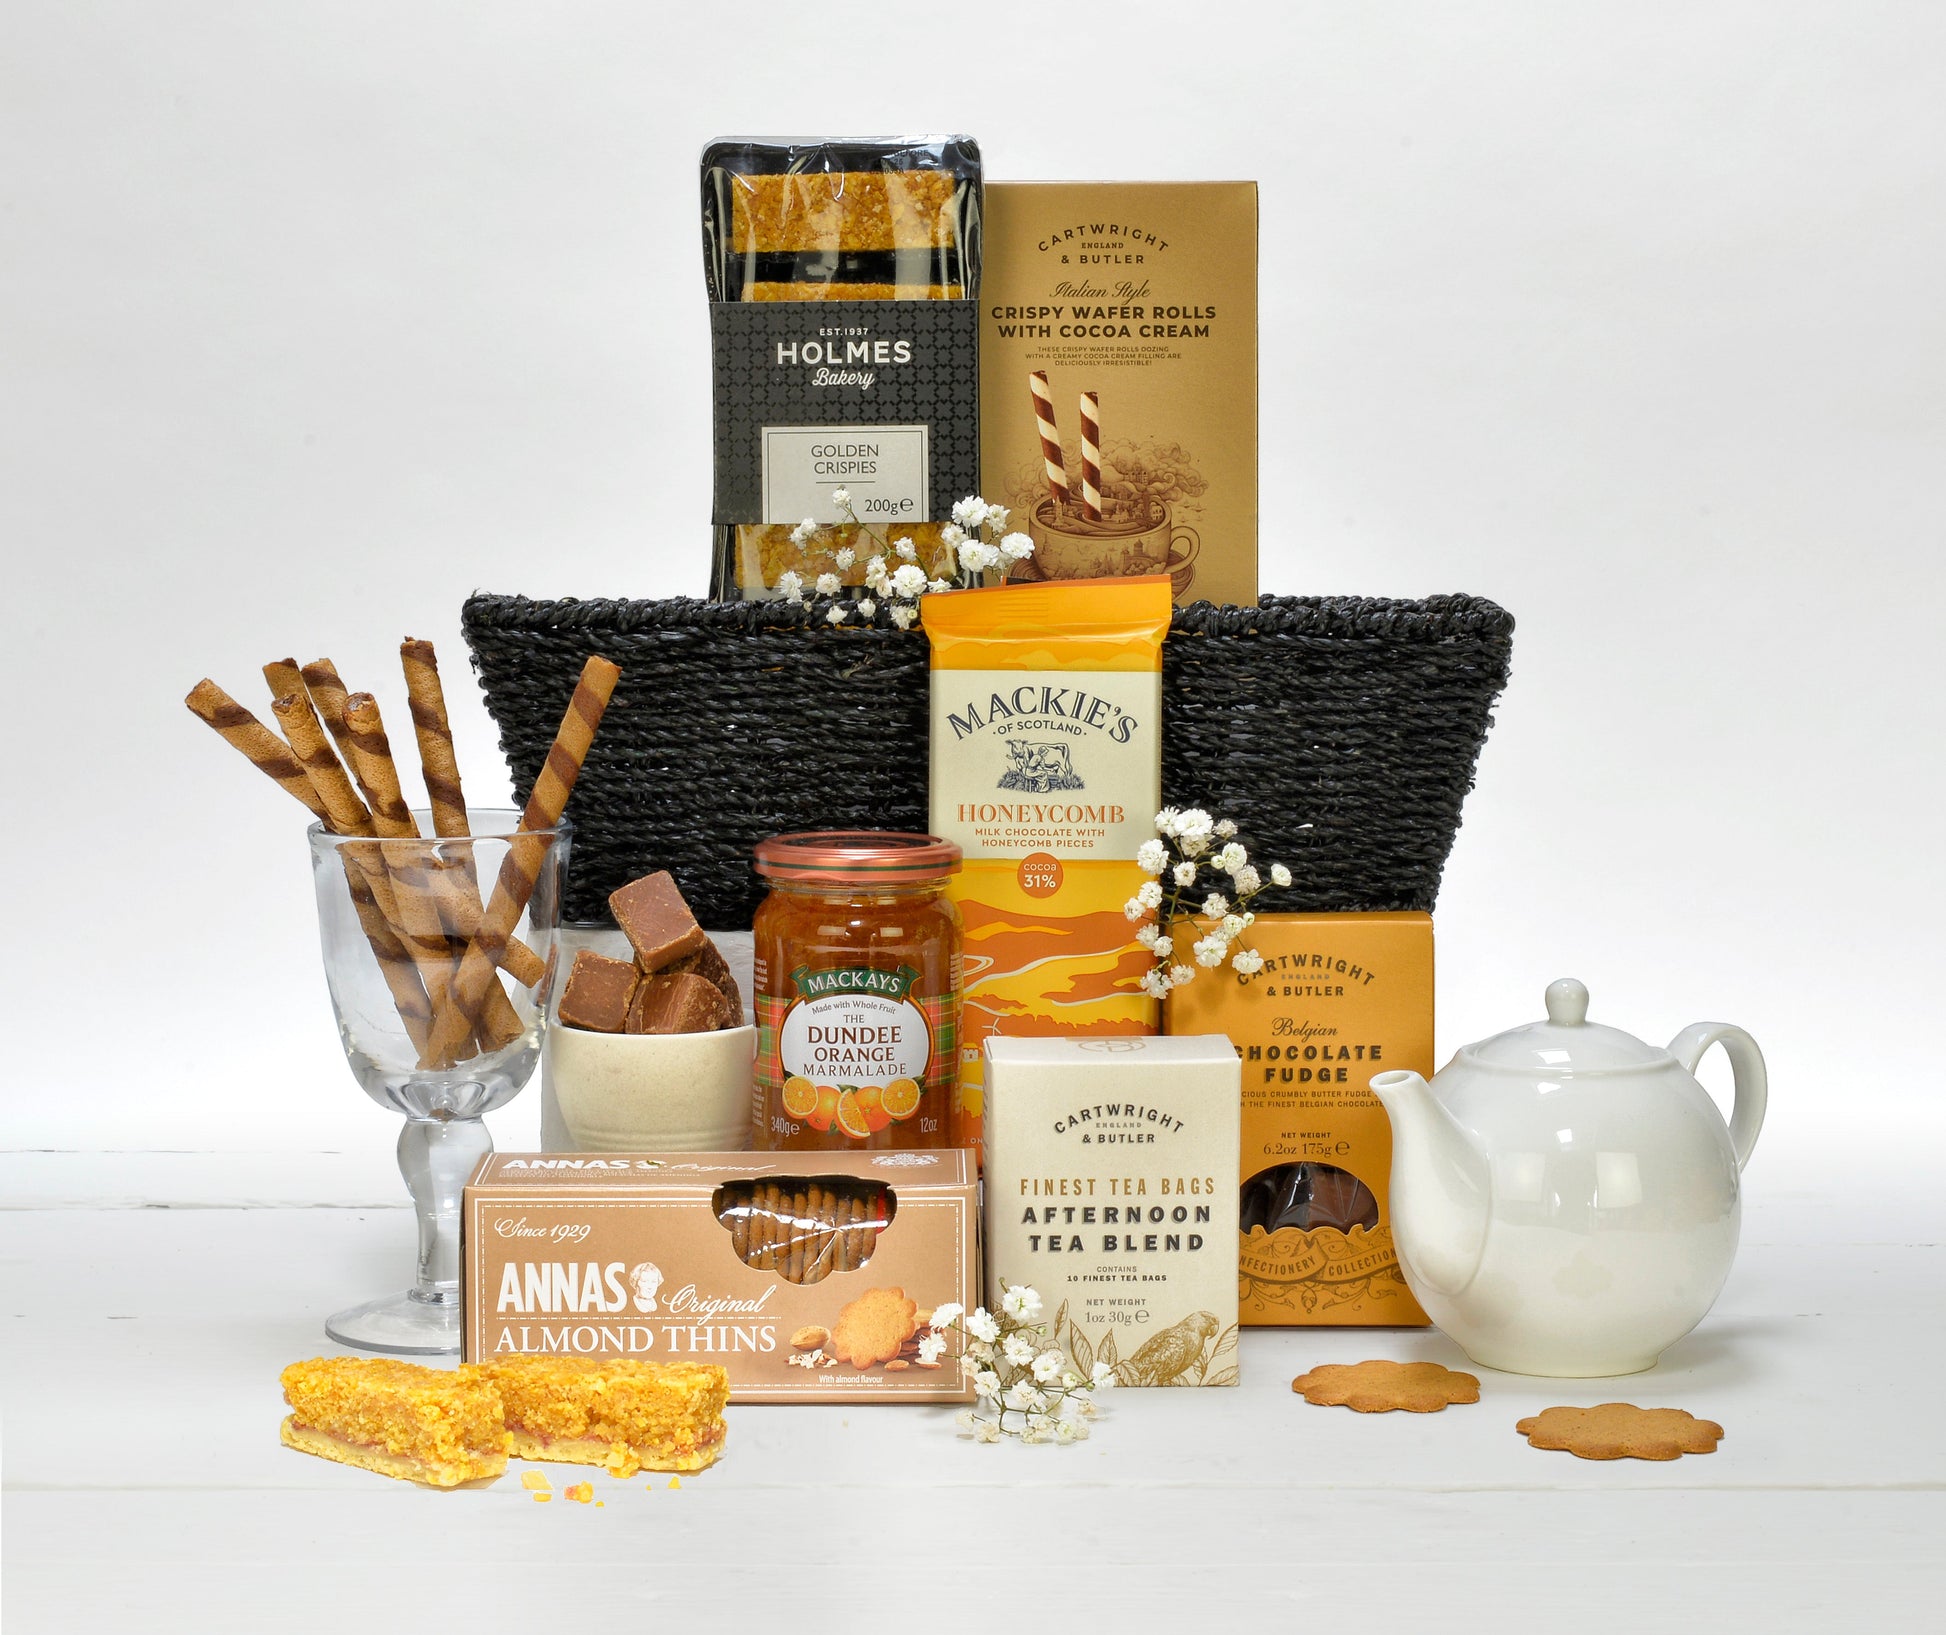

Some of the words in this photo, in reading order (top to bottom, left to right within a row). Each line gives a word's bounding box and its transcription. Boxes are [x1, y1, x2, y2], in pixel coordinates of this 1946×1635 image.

[1038, 224, 1169, 252] CARTWRIGHT
[1061, 255, 1070, 264] &
[1080, 255, 1145, 264] BUTLER
[1049, 280, 1108, 298] Italian
[1112, 279, 1151, 305] Style
[991, 306, 1065, 320] CRISPY
[1072, 306, 1144, 319] WAFER
[1153, 306, 1217, 319] ROLLS
[819, 327, 869, 336] EST.1937
[998, 325, 1051, 338] WITH
[1059, 324, 1131, 338] COCOA
[1139, 324, 1210, 338] CREAM
[777, 340, 911, 365] HOLMES
[812, 367, 875, 390] Bakery
[811, 444, 879, 457] GOLDEN
[814, 461, 877, 474] CRISPIES
[946, 686, 1139, 744] MACKIE'S
[997, 722, 1014, 735] OF
[1017, 720, 1083, 736] SCOTLAND
[957, 804, 1125, 824] HONEYCOMB
[975, 828, 1001, 836] MILK
[1005, 828, 1072, 837] CHOCOLATE
[1076, 829, 1105, 837] WITH
[982, 839, 1052, 848] HONEYCOMB
[1056, 839, 1094, 848] PIECES
[1024, 875, 1056, 888] 31%
[808, 972, 900, 994] MACKAYS
[1267, 986, 1276, 996] &
[1283, 986, 1344, 996] BUTLER
[811, 1003, 832, 1015] Made
[833, 1001, 850, 1009] with
[852, 1000, 877, 1010] Whole
[879, 1003, 896, 1015] Fruit
[843, 1015, 864, 1023] THE
[808, 1025, 902, 1045] DUNDEE
[1271, 1017, 1338, 1042] Belgian
[814, 1047, 895, 1062] ORANGE
[803, 1063, 907, 1076] MARMALADE
[1265, 1067, 1348, 1082] FUDGE
[920, 1117, 938, 1134] 12oz
[1054, 1104, 1184, 1134] CARTWRIGHT
[1082, 1134, 1091, 1144] &
[1098, 1134, 1155, 1143] BUTLER
[1263, 1143, 1297, 1155] 6.2oz
[1302, 1143, 1332, 1157] 175g
[502, 1159, 631, 1169] ANNAS
[1020, 1178, 1096, 1195] FINEST
[1110, 1178, 1146, 1195] TEA
[1161, 1177, 1214, 1195] BAGS
[1021, 1205, 1211, 1224] AFTERNOON
[494, 1217, 546, 1238] Since
[550, 1224, 591, 1244] 1929
[1029, 1234, 1084, 1251] TEA
[1102, 1234, 1204, 1251] BLEND
[497, 1262, 627, 1313] ANNAS
[662, 1284, 777, 1326] Original
[1085, 1312, 1105, 1323] 1oz
[1109, 1312, 1132, 1326] 30g
[494, 1325, 654, 1353] ALMOND
[662, 1325, 776, 1353] THINS
[819, 1375, 835, 1384] With
[835, 1374, 860, 1384] almond
[860, 1374, 884, 1384] flavour
